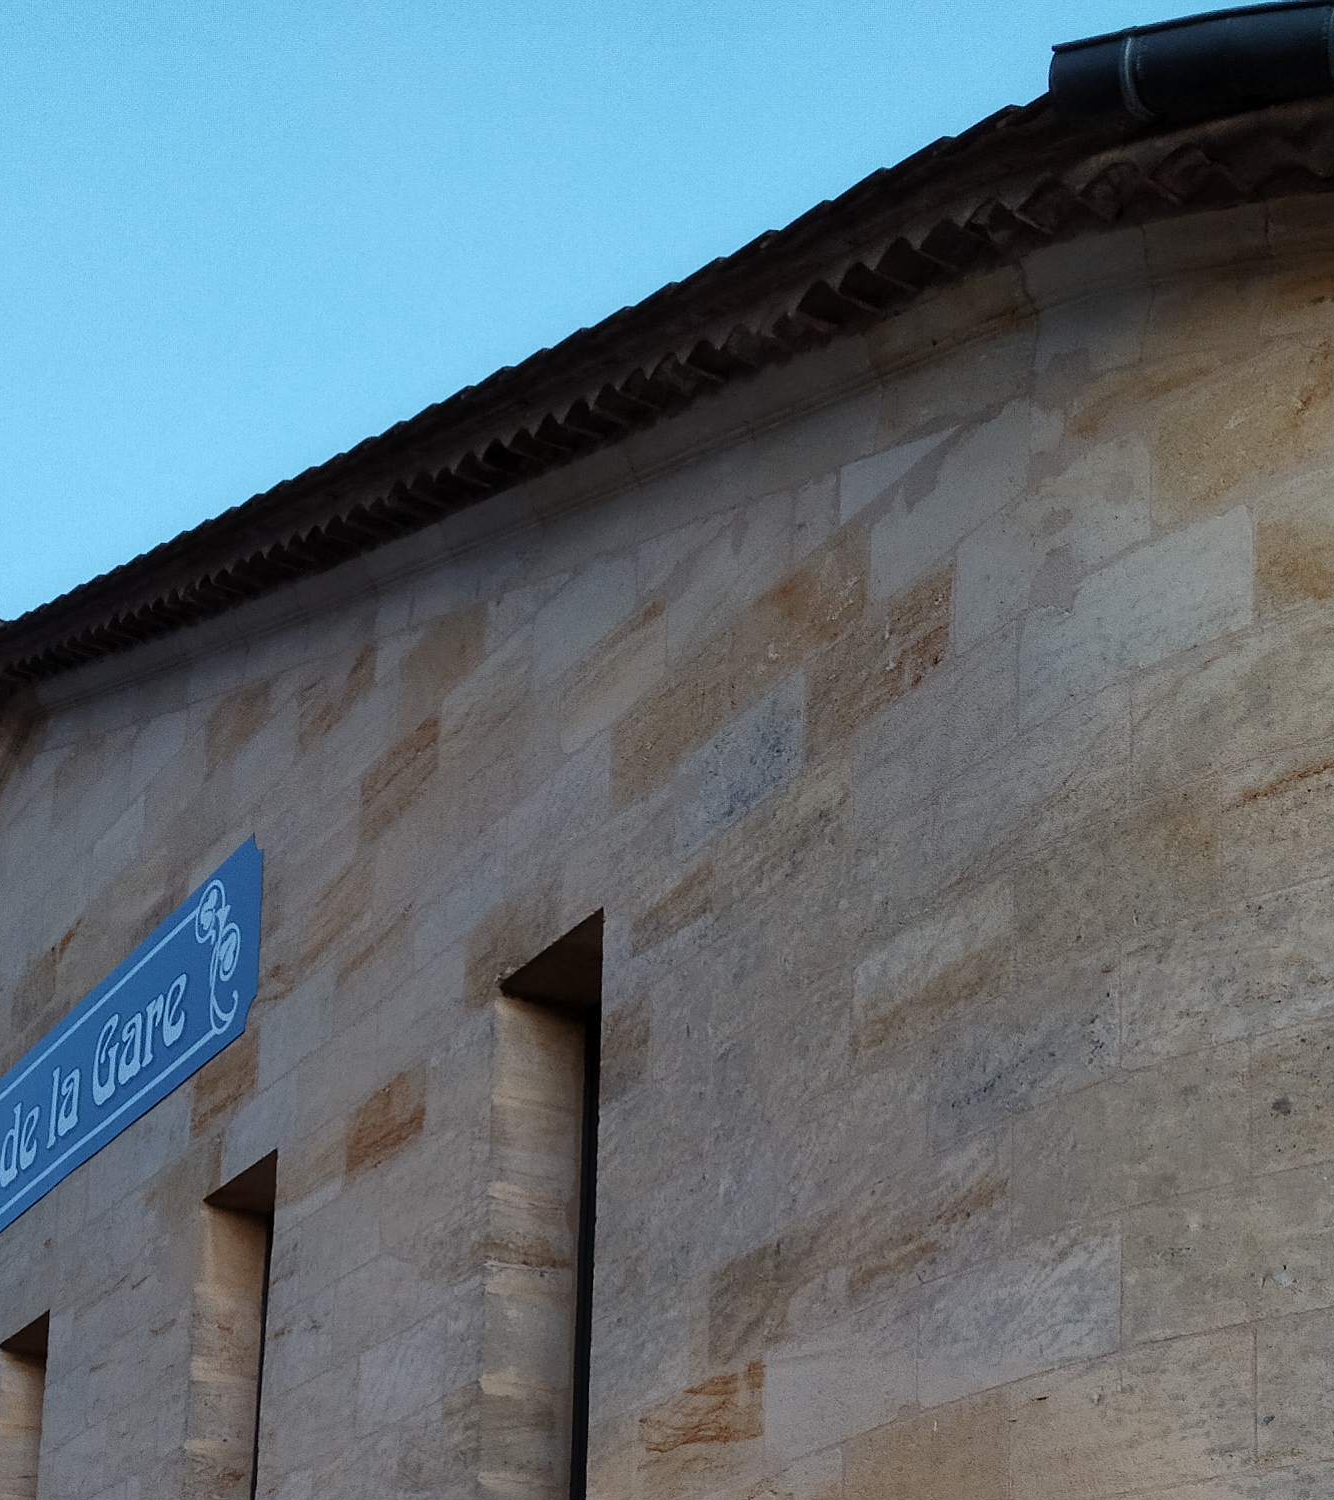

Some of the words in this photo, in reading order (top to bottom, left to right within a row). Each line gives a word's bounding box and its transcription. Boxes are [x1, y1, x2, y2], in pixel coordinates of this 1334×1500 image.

[0, 1101, 40, 1188] de
[46, 1066, 81, 1149] la
[92, 972, 187, 1107] Gare
